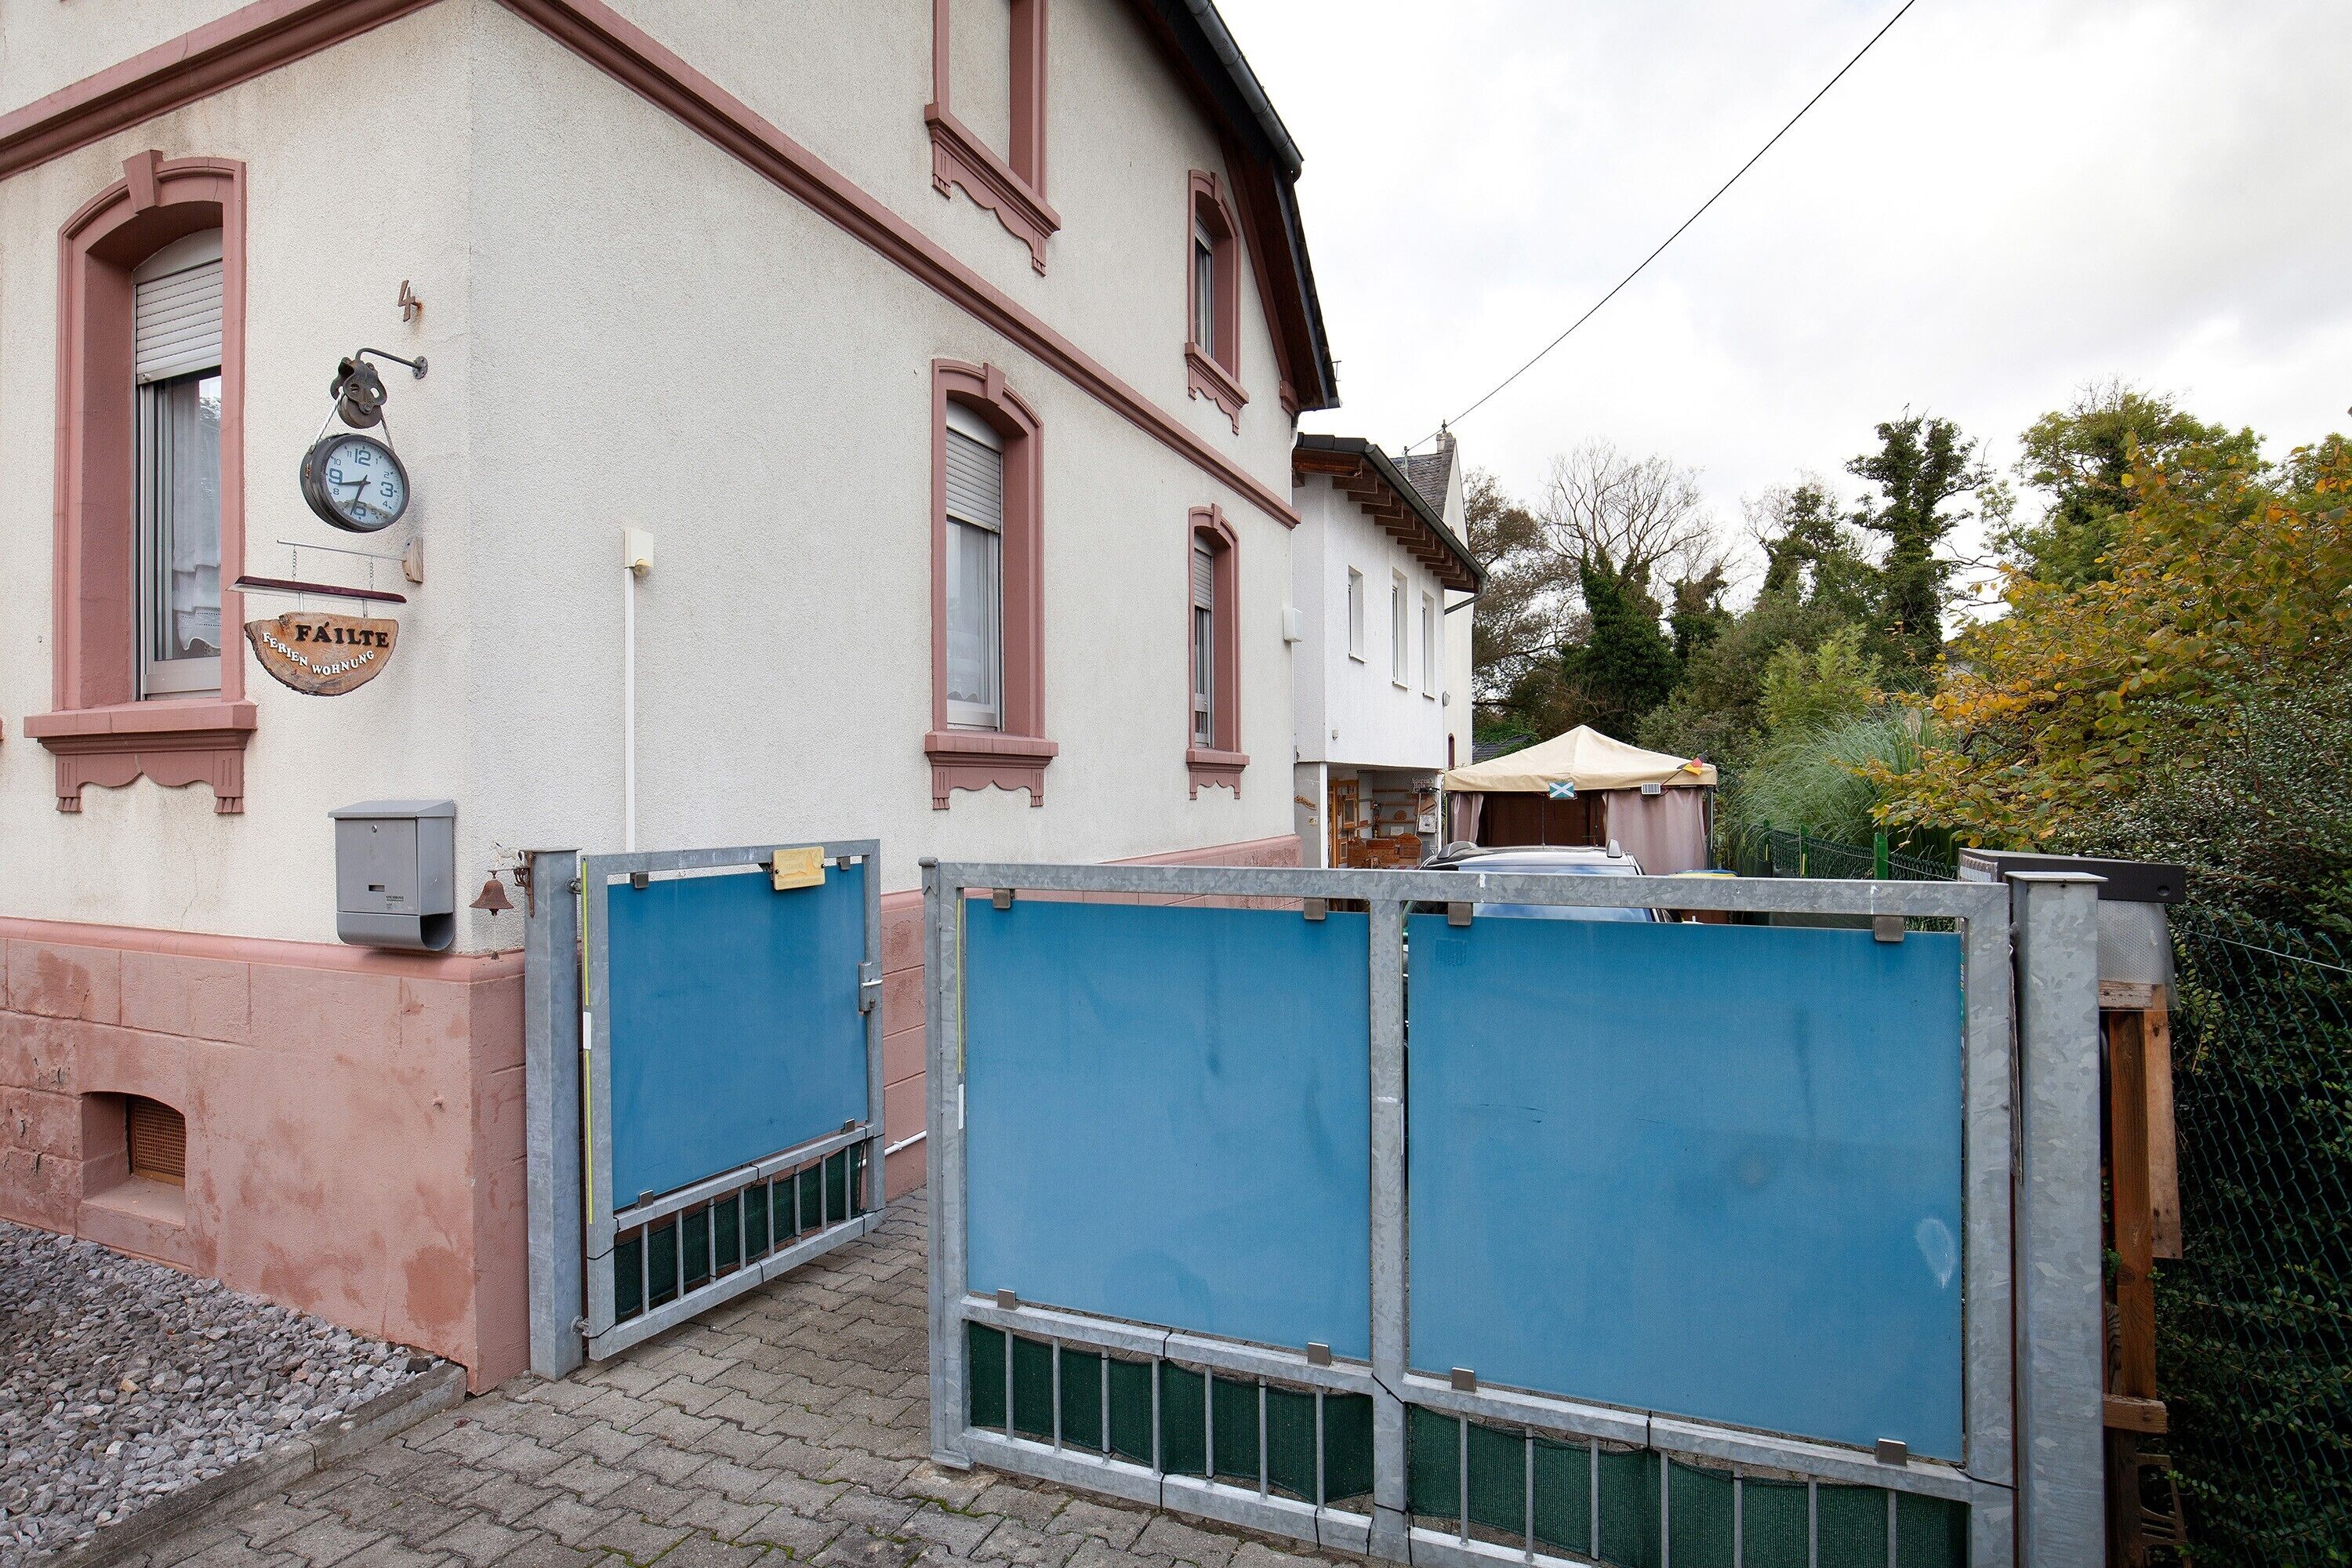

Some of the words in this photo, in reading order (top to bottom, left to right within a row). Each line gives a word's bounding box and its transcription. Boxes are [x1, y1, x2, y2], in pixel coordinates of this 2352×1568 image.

[397, 279, 416, 322] 4
[354, 448, 372, 466] 12
[328, 467, 343, 486] 9
[379, 481, 394, 498] 3
[295, 622, 390, 648] FÁILTE
[263, 632, 308, 666] FERIEN
[312, 650, 375, 676] WOHNUNG
